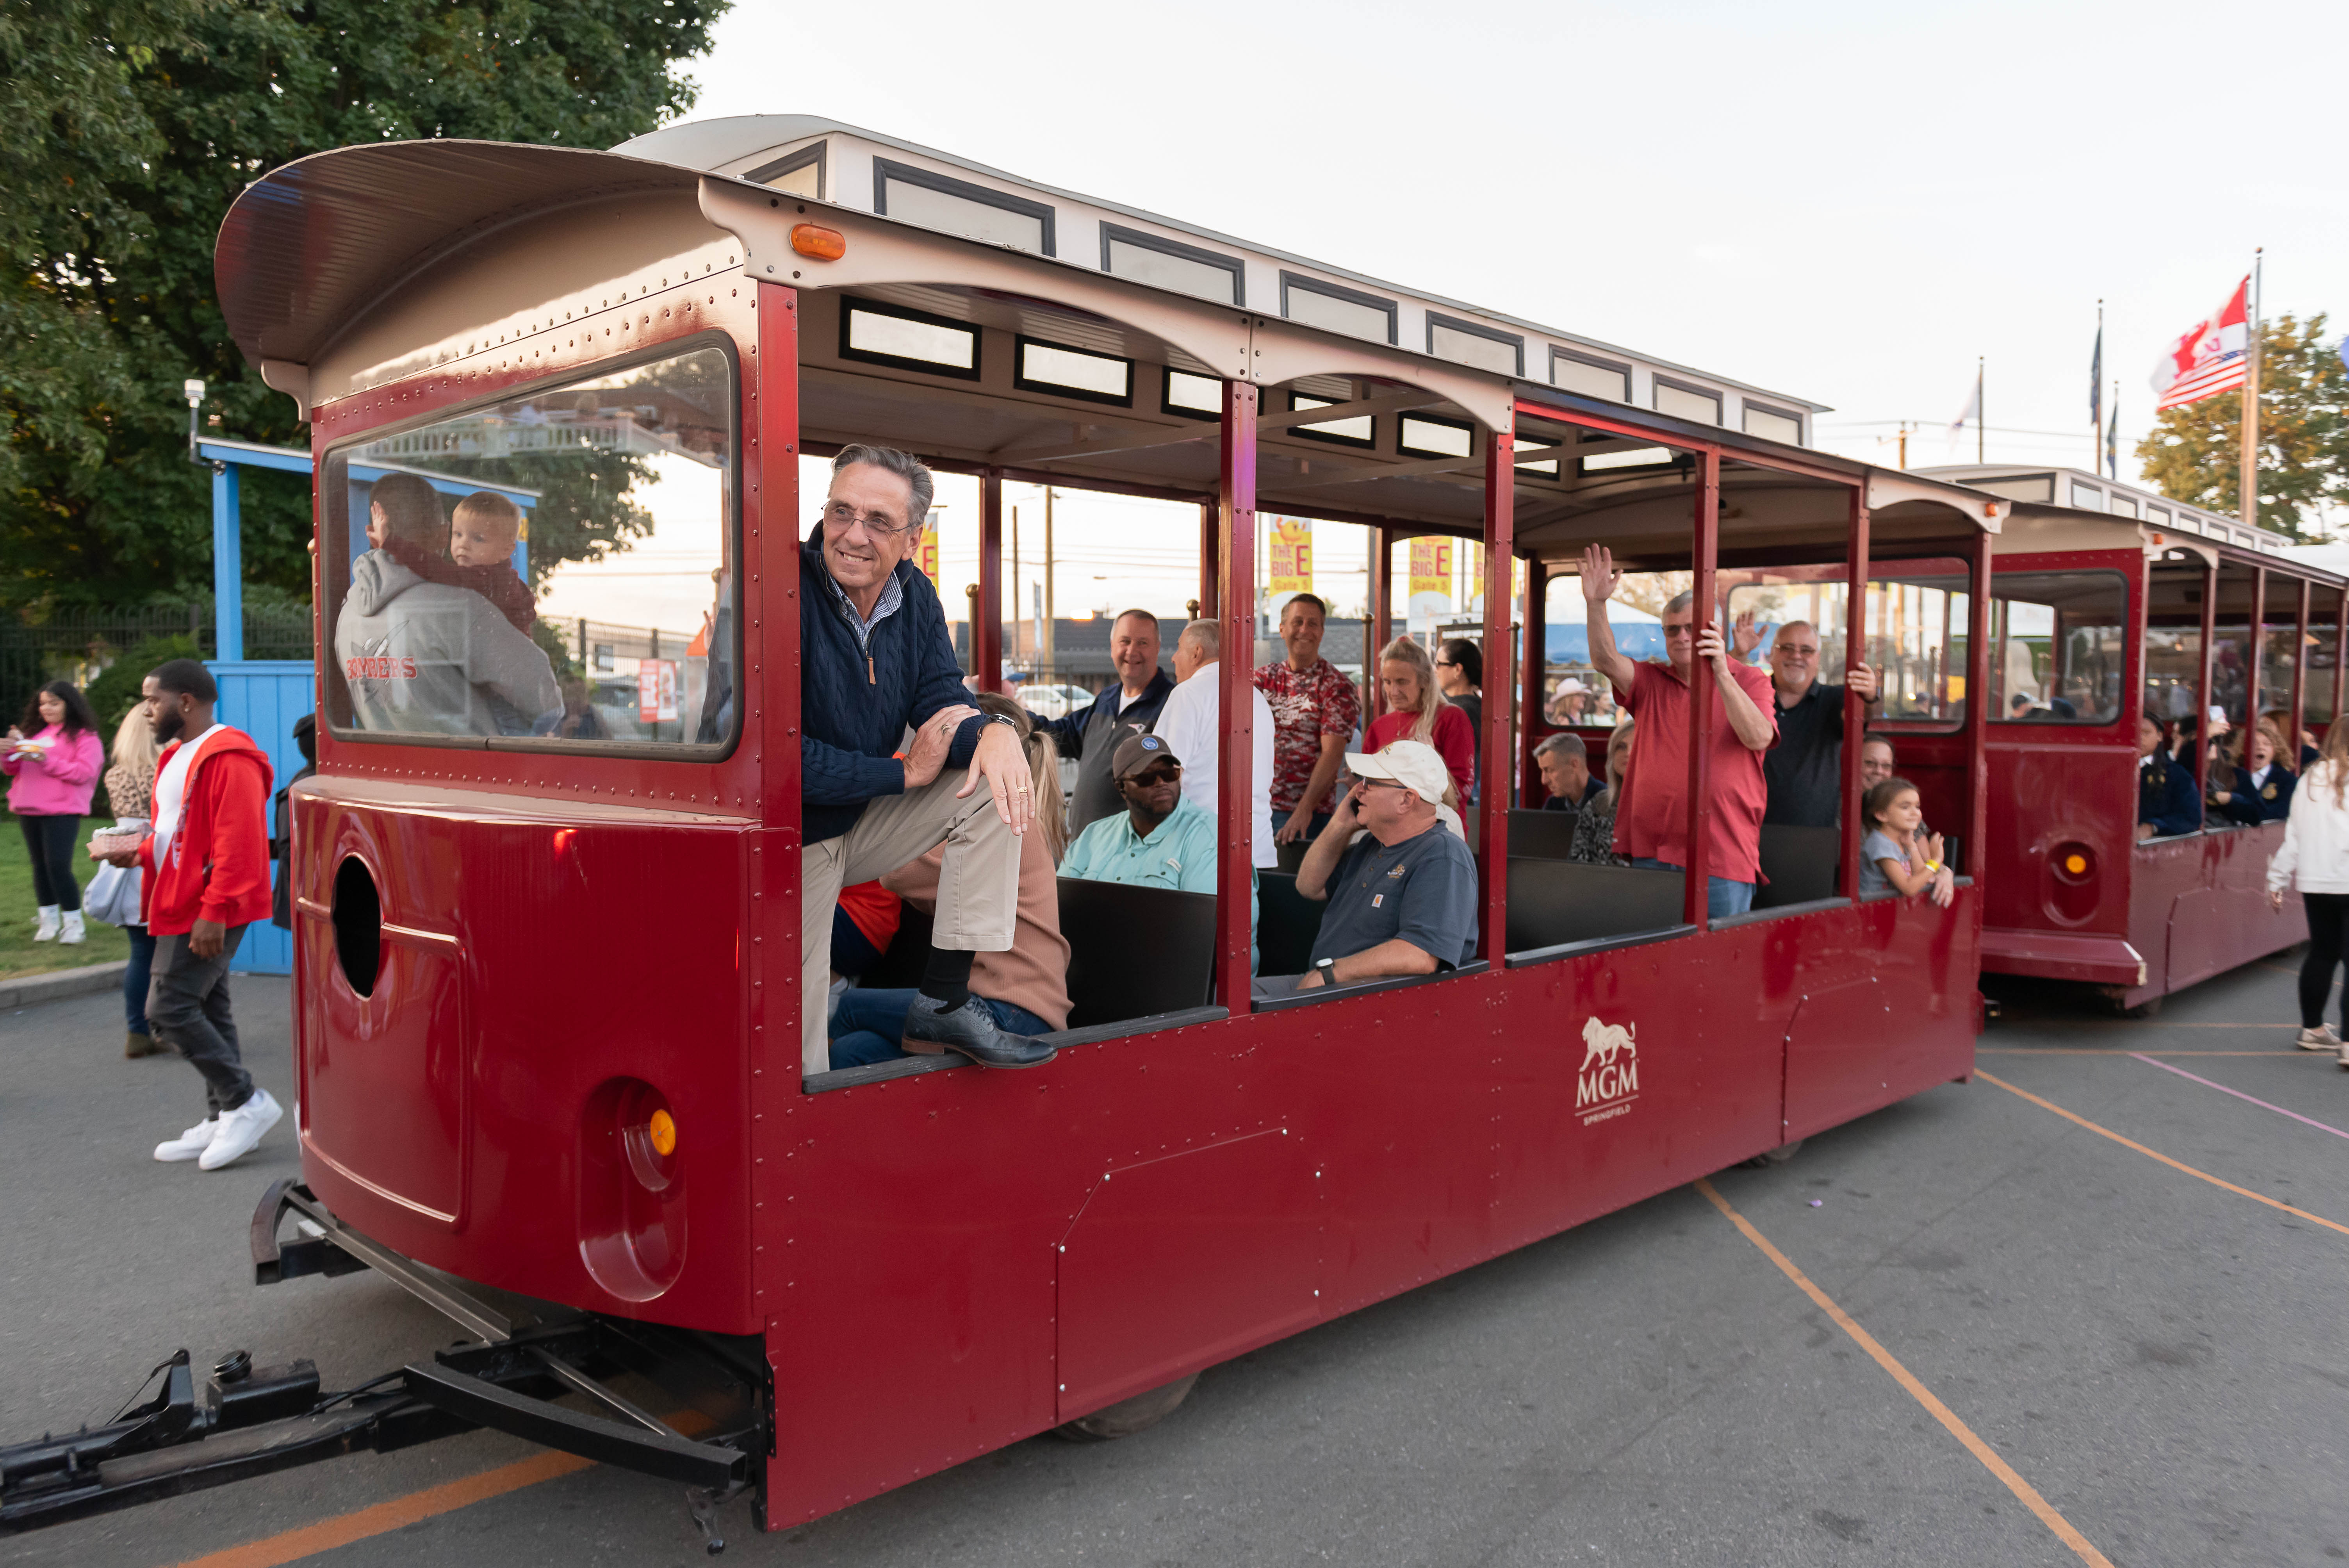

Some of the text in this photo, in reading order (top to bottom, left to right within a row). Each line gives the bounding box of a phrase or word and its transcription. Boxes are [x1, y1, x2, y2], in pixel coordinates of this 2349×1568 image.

[923, 546, 935, 576] E
[1272, 544, 1293, 558] THE
[1296, 545, 1310, 576] E
[1412, 544, 1433, 558] THE
[1436, 545, 1449, 576] E
[1272, 561, 1294, 577] BIG
[1411, 561, 1433, 577] BIG
[346, 656, 417, 680] BOMBERS
[1575, 1059, 1639, 1108] MGM
[1583, 1103, 1631, 1126] SPRINGFIELD
